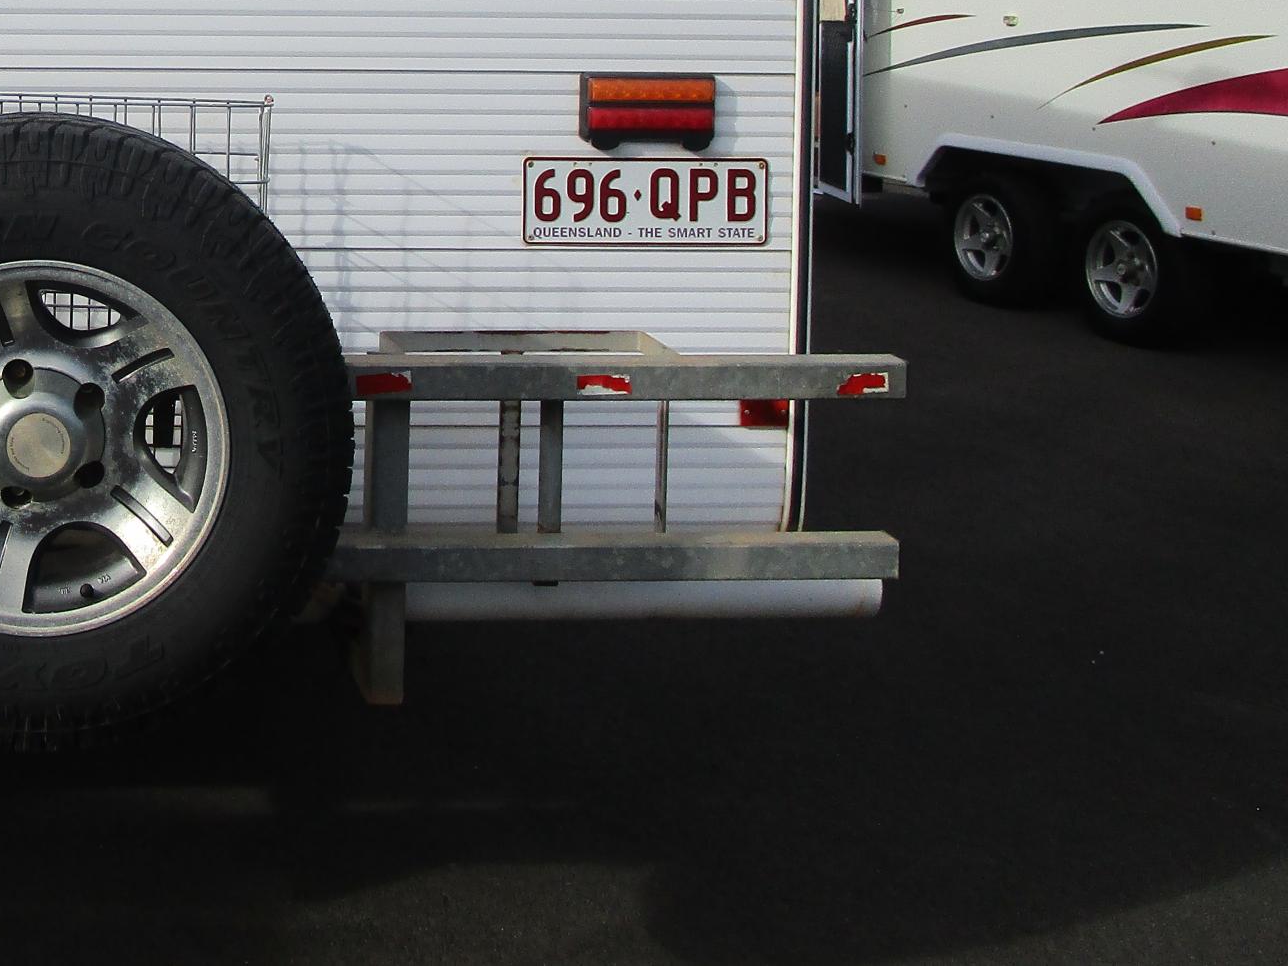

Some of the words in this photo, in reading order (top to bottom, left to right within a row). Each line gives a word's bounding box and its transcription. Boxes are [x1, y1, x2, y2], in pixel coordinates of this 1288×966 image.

[533, 227, 622, 239] QUEENSLAND
[637, 227, 662, 238] THE
[668, 227, 712, 238] SMART
[717, 227, 755, 238] STATE
[79, 217, 284, 477] COUNTRY
